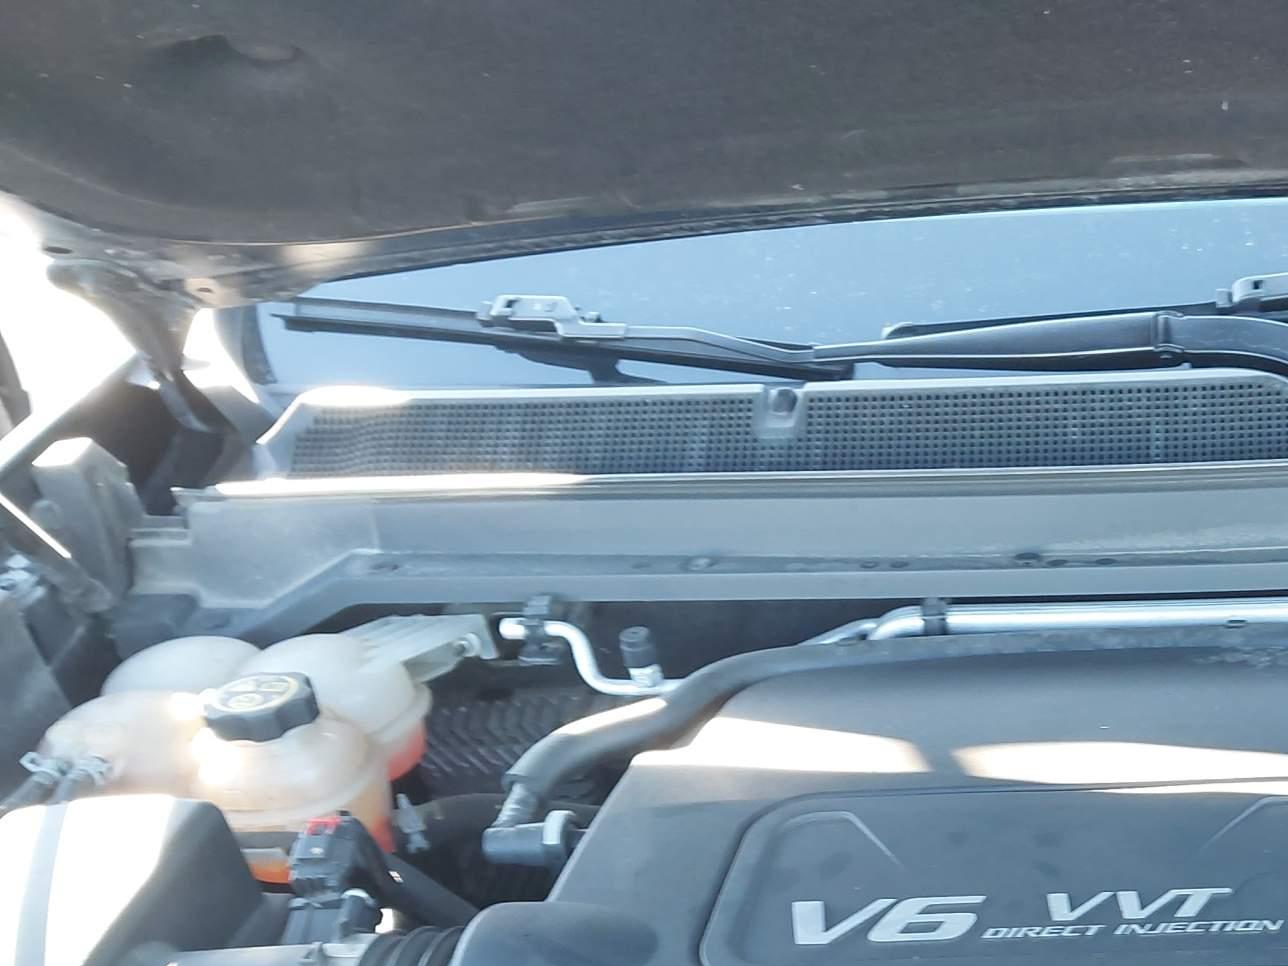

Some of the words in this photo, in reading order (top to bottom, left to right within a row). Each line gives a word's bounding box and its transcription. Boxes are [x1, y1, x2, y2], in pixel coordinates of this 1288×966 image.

[790, 895, 987, 945] V6
[1046, 887, 1233, 922] VVT
[980, 924, 1106, 939] DIRECT
[1113, 919, 1285, 936] INJECTION
